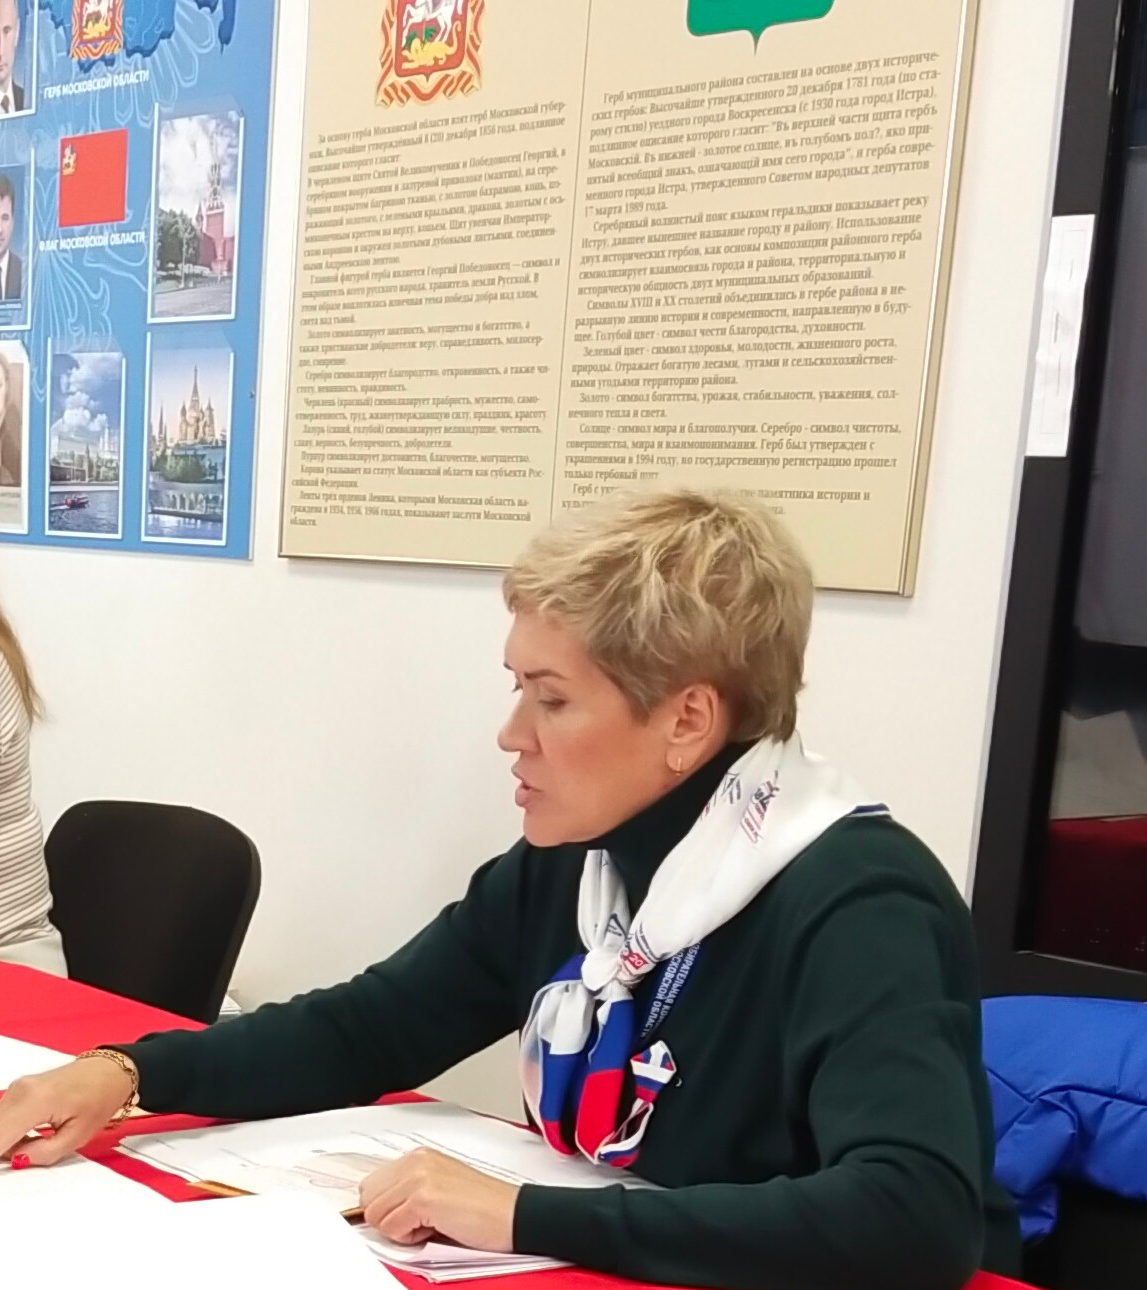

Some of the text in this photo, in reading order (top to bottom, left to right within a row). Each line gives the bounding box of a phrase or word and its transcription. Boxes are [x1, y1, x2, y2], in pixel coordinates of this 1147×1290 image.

[44, 70, 149, 100] ГЕРБ МОСКОВСКОЙ ОБЛАСТИ
[603, 89, 624, 104] Герб
[799, 67, 813, 77] на
[854, 59, 880, 71] двух
[39, 232, 145, 252] ФЛАГ МОСКОВСКОЙ ОБЛАСТИ
[655, 949, 684, 1000] ОСКОВСКОЙ
[665, 942, 701, 1004] ЗБИРАТЕЛЬНАЯ
